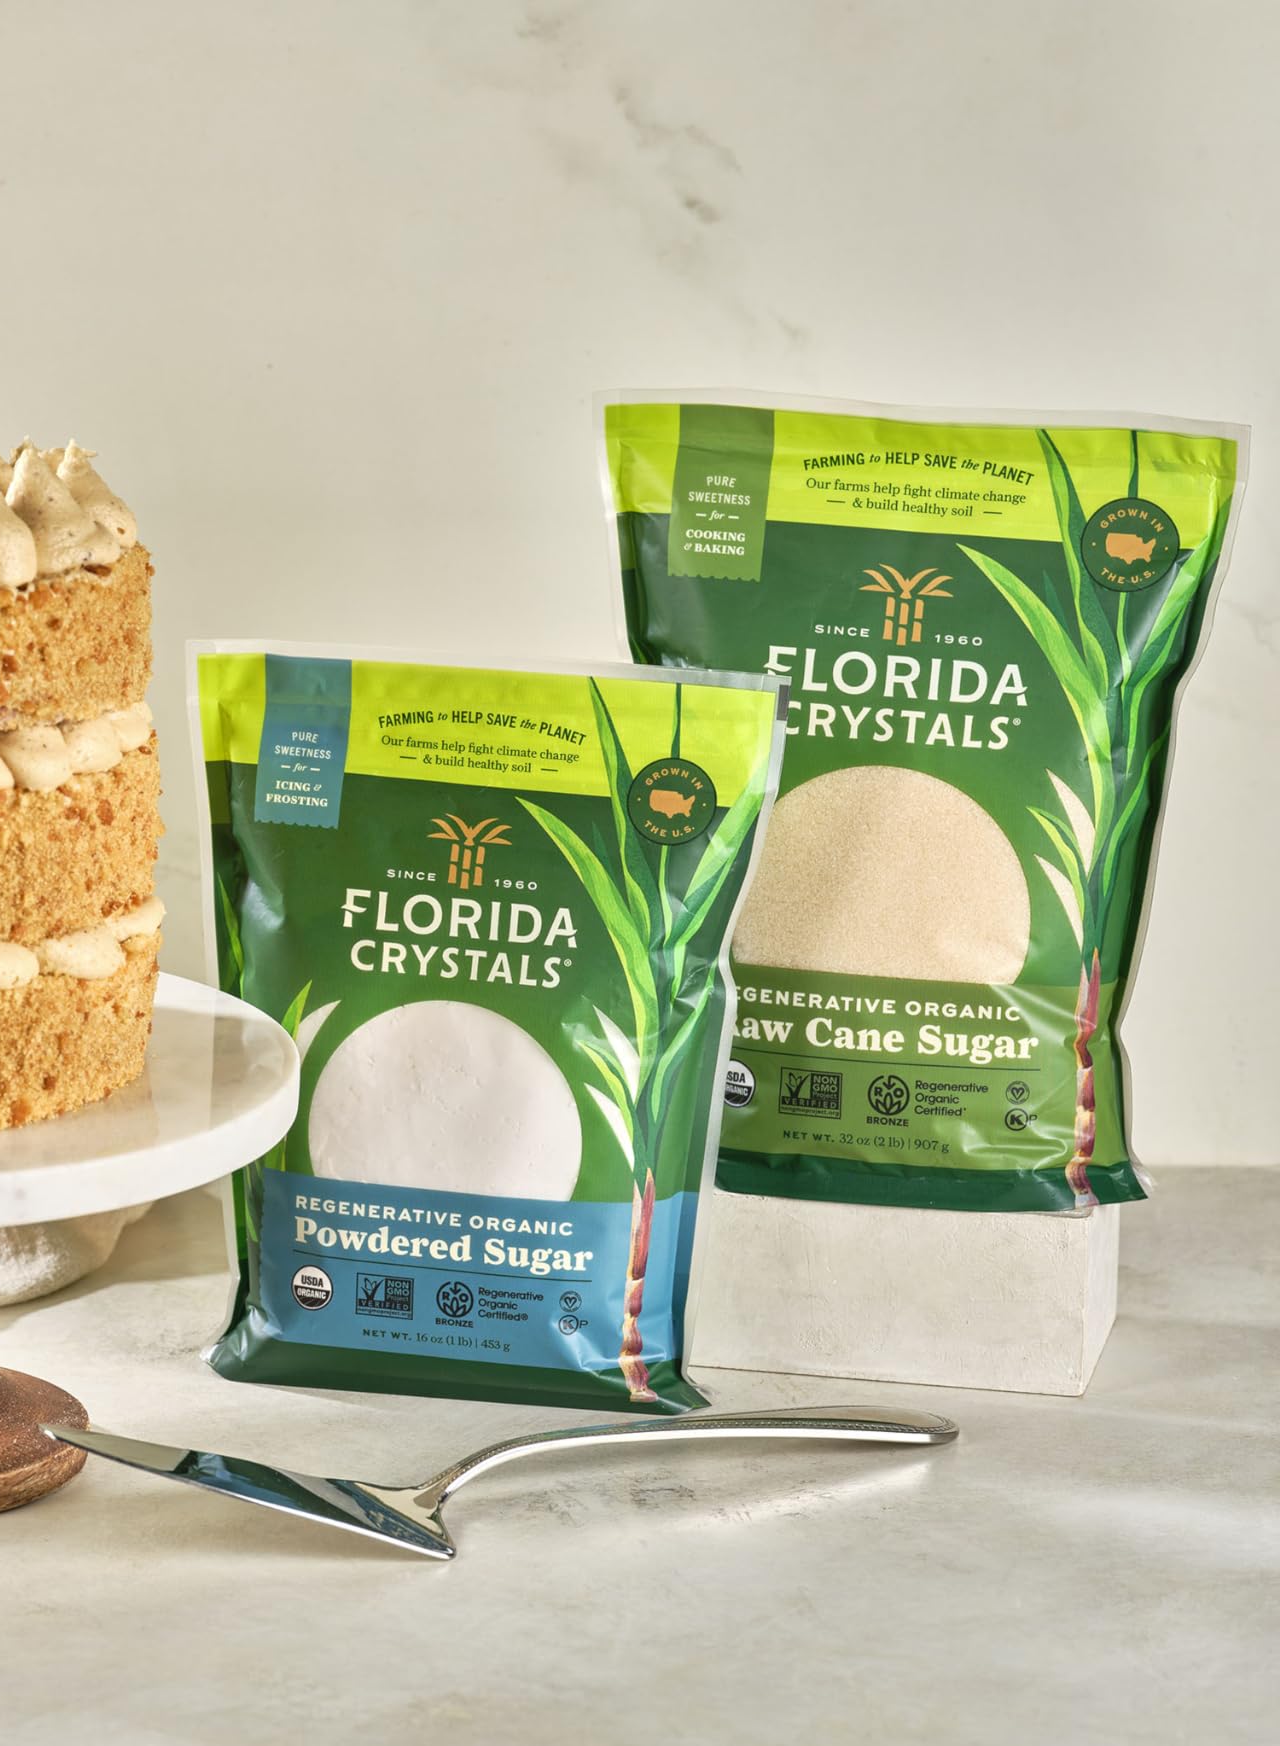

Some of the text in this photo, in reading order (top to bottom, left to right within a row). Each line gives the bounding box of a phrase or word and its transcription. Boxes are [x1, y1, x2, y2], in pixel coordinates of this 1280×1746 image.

[803, 452, 1034, 486] FARMING to HELP SAVE the PLANET
[706, 475, 736, 488] PURE
[688, 491, 750, 506] SWEETNESS
[806, 478, 1026, 505] Our farms help fight climate change
[852, 498, 973, 517] & build healthy soil
[708, 510, 725, 520] for
[1100, 508, 1164, 532] GROWN IN
[686, 529, 745, 542] COOKING
[694, 543, 744, 556] BAKING
[1101, 567, 1155, 584] THE U.S.
[815, 625, 983, 646] SINCE 1960
[764, 645, 1028, 706] FLORIDA
[379, 711, 586, 746] FARMING to HELP SAVE the PLANET
[292, 732, 319, 744] PURE
[274, 745, 331, 760] SWEETNESS
[381, 735, 580, 763] Our farms help fight climate change
[292, 763, 307, 772] for
[423, 754, 531, 773] & build healthy soil
[275, 780, 311, 792] ICING
[645, 768, 703, 790] GROWN IN
[266, 793, 328, 807] FROSTING
[644, 820, 695, 837] THE U.S.
[387, 869, 537, 890] SINCE 1960
[341, 888, 578, 948] FLORIDA
[736, 985, 1021, 1022] GENERATIVE ORGANIC
[806, 1017, 905, 1052] Cane
[917, 1024, 1039, 1065] Sugar
[727, 1071, 746, 1083] SDA
[814, 1075, 837, 1085] NON
[812, 1084, 838, 1093] GMO
[915, 1080, 989, 1093] Regenerative
[784, 1099, 837, 1108] VERIFIED
[915, 1093, 959, 1105] Organic
[866, 1116, 909, 1127] BRONZE
[783, 1130, 808, 1140] NET
[812, 1134, 834, 1143] WT.
[840, 1133, 853, 1144] 32
[873, 1136, 886, 1148] (2
[888, 1136, 905, 1149] lb)
[914, 1139, 938, 1149] 907
[295, 1195, 573, 1236] REGENERATIVE ORGANIC
[294, 1216, 593, 1275] Powdered Sugar
[301, 1275, 324, 1288] USDA
[387, 1280, 409, 1288] NON
[297, 1288, 326, 1299] ORGANIC
[387, 1287, 409, 1296] GMO
[478, 1287, 544, 1301] Regenerative
[361, 1300, 409, 1310] VERIFIED
[478, 1299, 518, 1310] Organic
[435, 1318, 473, 1328] BRONZE
[363, 1329, 501, 1349] NET WT. 16 oz (1 lb) 453
